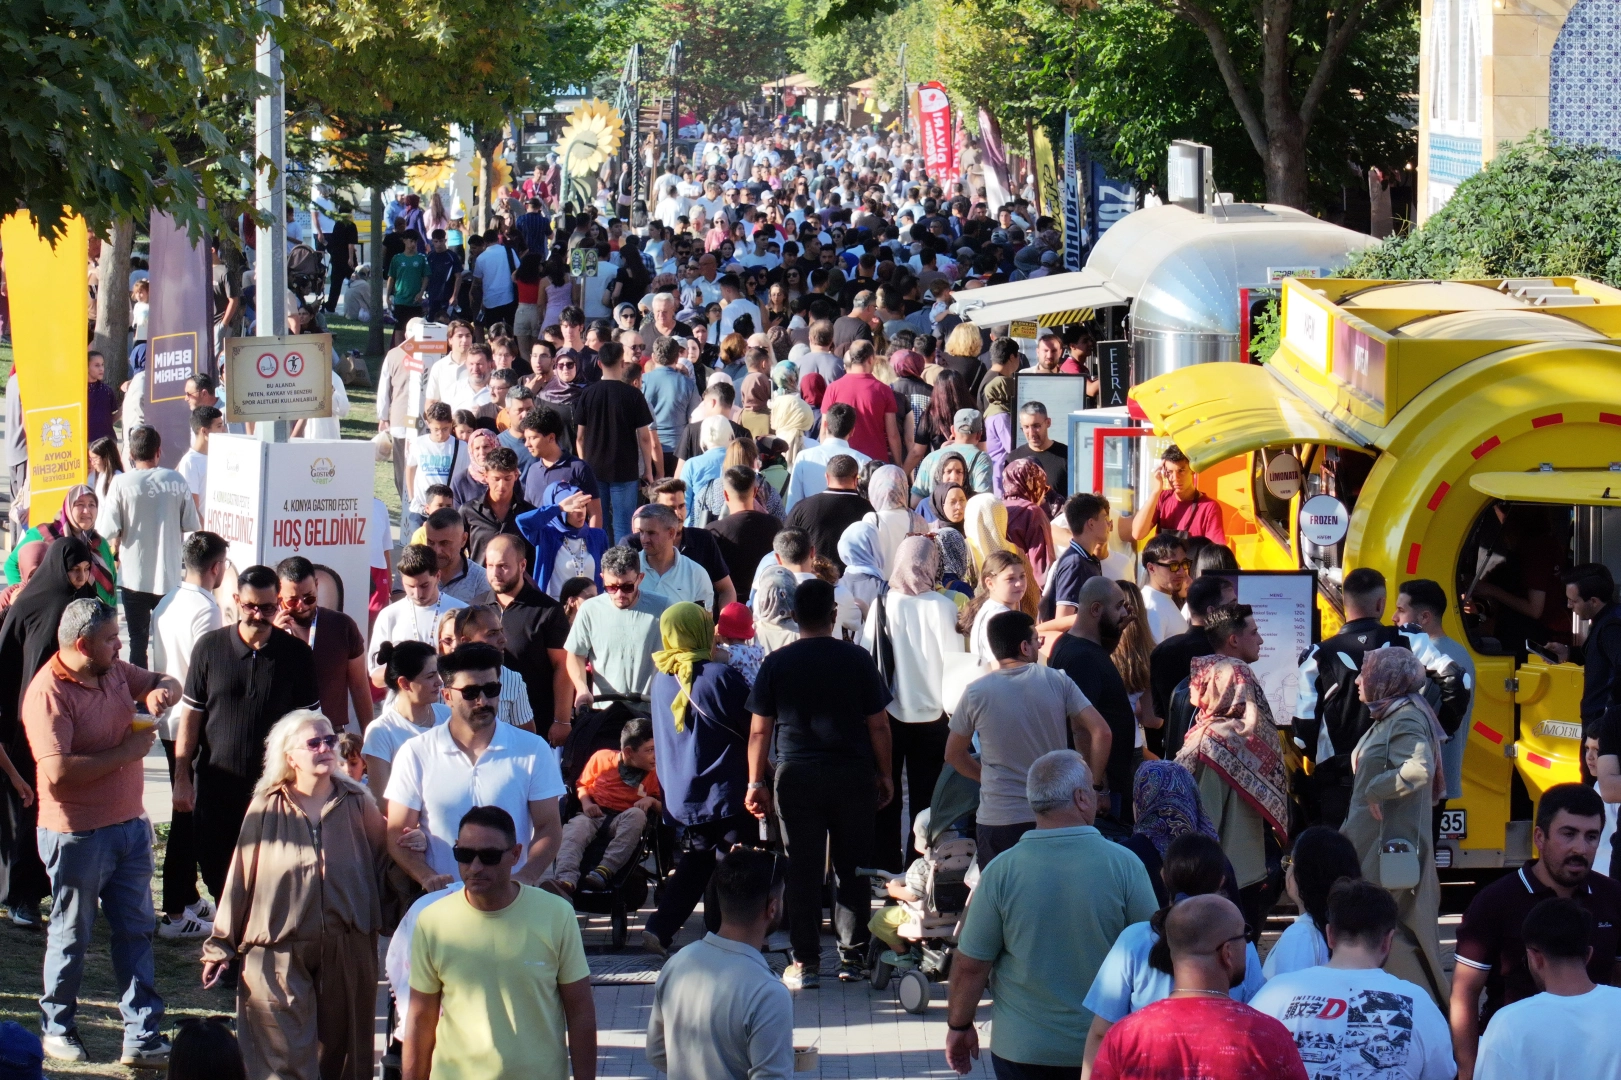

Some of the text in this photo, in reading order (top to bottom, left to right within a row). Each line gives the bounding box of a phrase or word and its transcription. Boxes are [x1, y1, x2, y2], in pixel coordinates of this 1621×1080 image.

[1109, 348, 1122, 405] FERA
[1269, 470, 1299, 482] LİMONATA
[283, 498, 358, 512] 4. KONYA GASTRO FEST'E
[1309, 515, 1339, 525] FROZEN
[272, 513, 367, 552] HOŞ GELDİNİZ
[1440, 813, 1462, 832] 35
